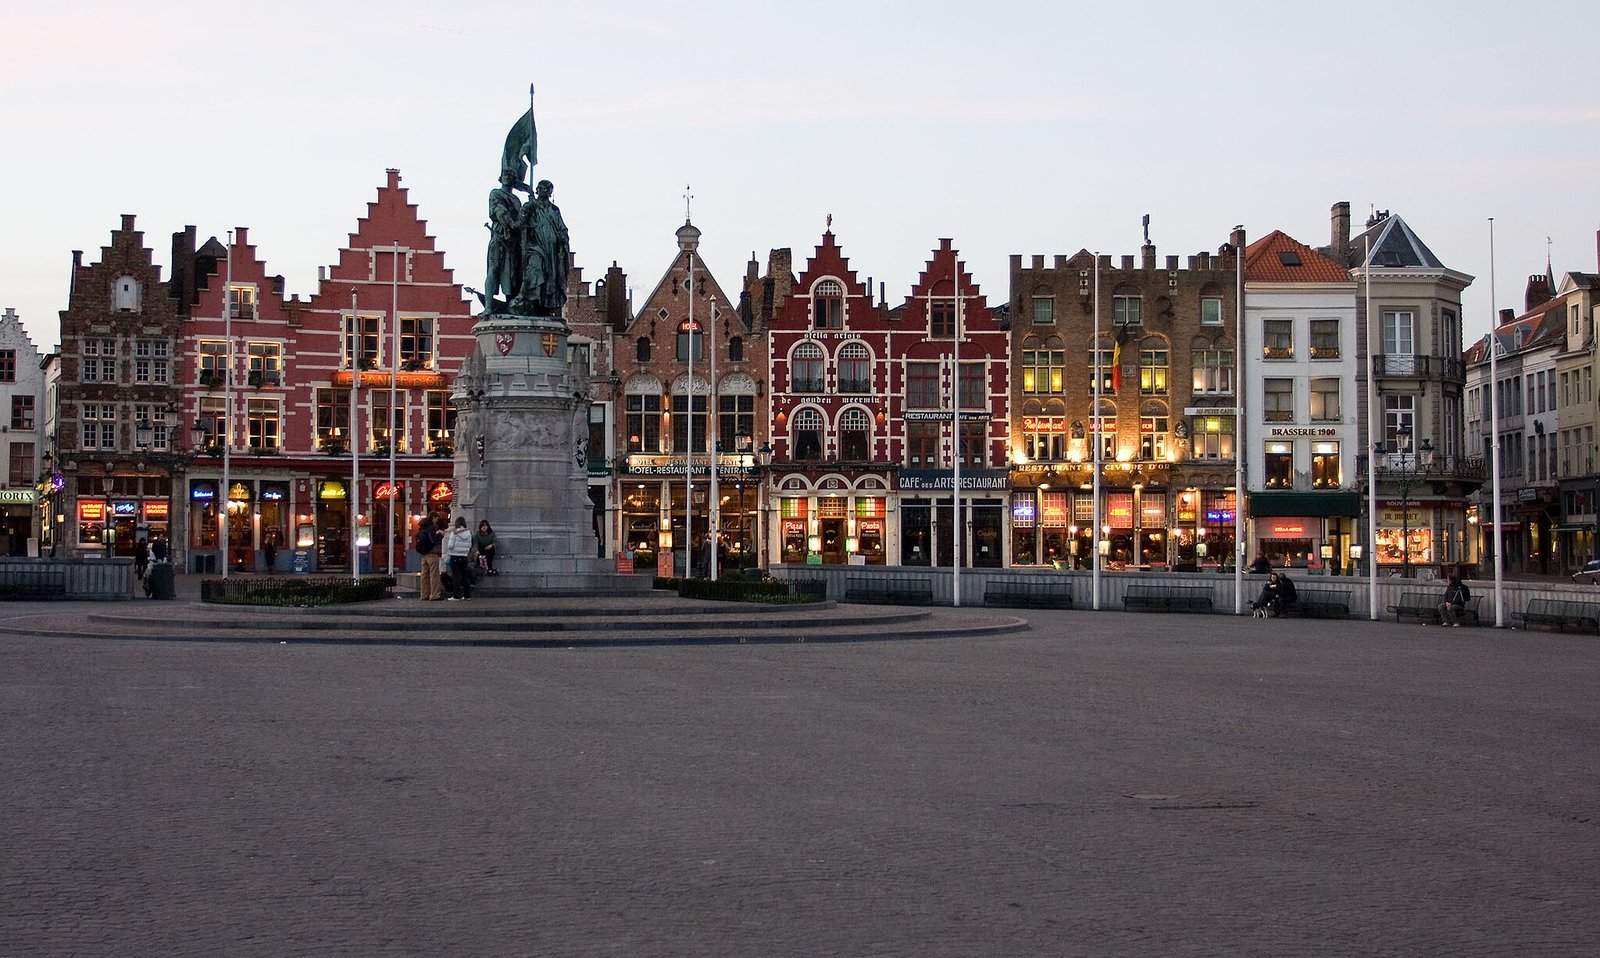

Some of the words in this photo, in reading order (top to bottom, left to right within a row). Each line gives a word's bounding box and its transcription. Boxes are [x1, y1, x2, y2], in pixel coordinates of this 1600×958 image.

[682, 322, 698, 330] HOEL
[905, 412, 952, 420] RESTAURANT
[1271, 428, 1316, 436] BRASSERIE
[1317, 428, 1336, 436] 1900
[1018, 463, 1082, 472] RESTAURANT
